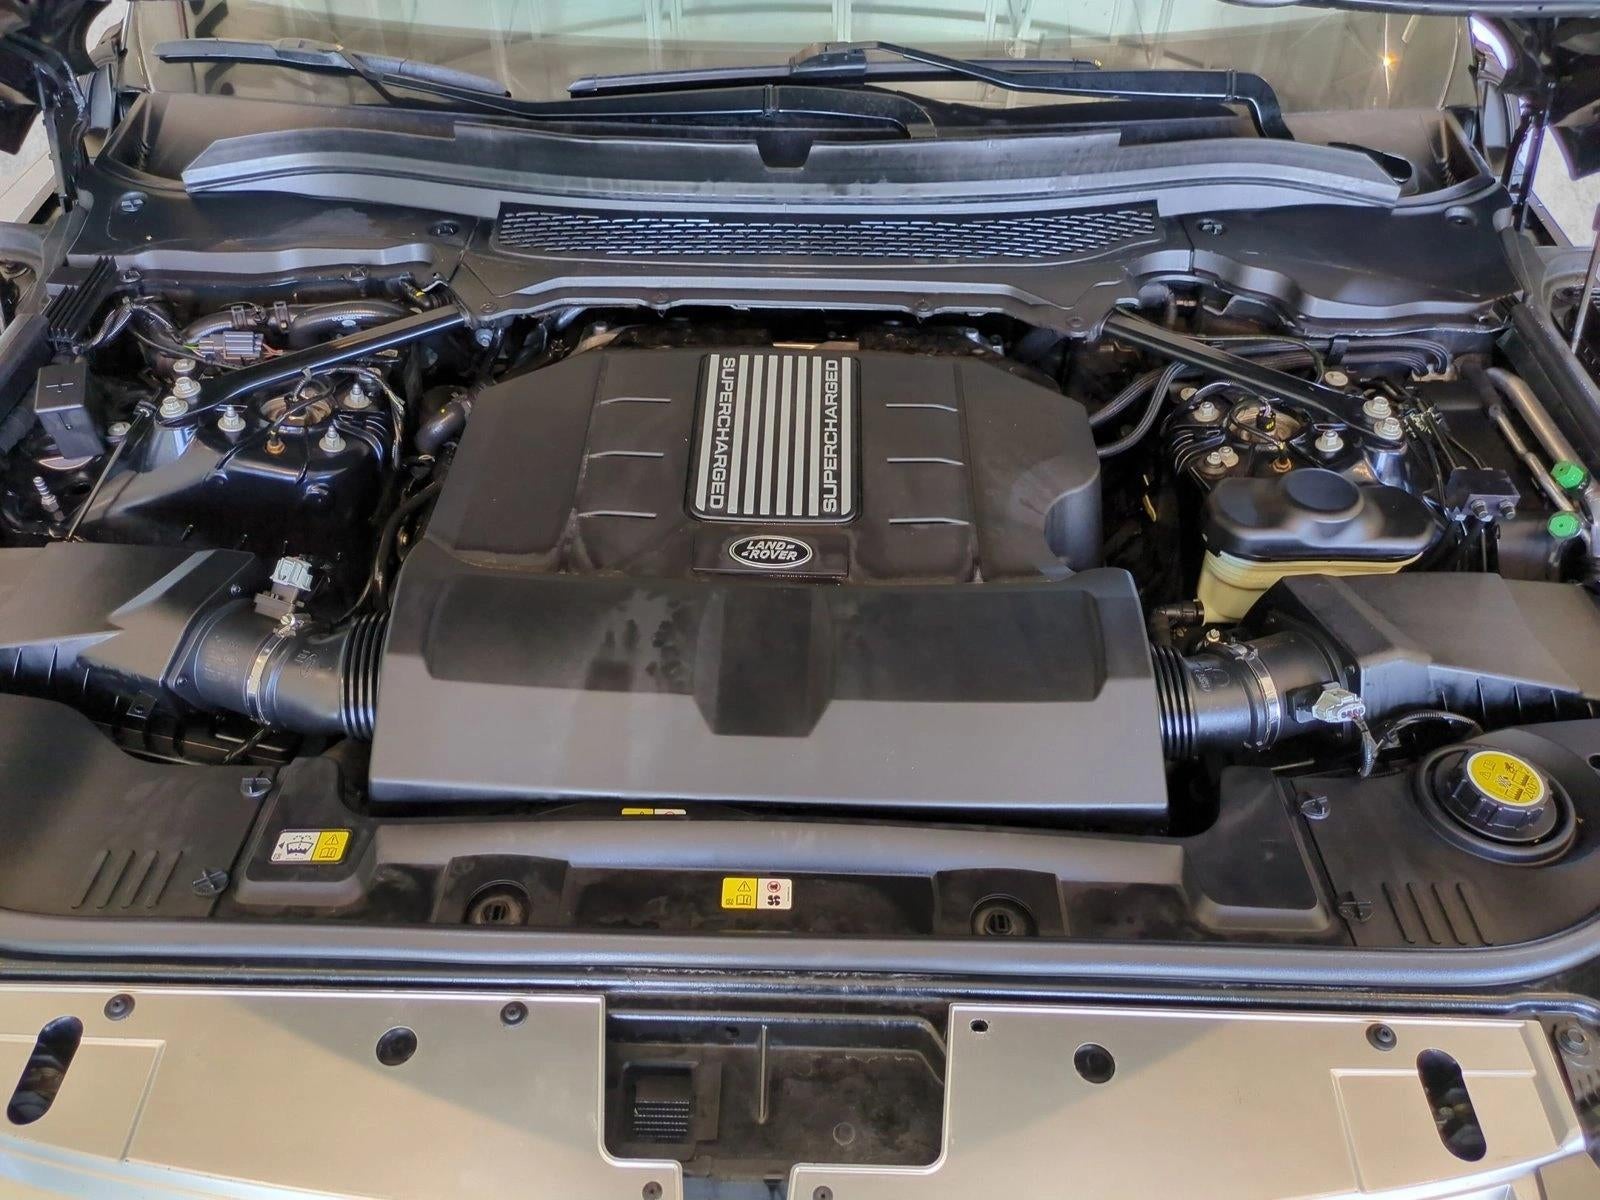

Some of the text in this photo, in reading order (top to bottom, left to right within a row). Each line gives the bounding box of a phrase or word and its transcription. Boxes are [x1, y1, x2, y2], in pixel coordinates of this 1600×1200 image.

[710, 357, 735, 509] SUPERCHARGED
[823, 359, 838, 513] SUPERCHARGED
[746, 541, 786, 550] LAND
[748, 549, 798, 560] ROVER
